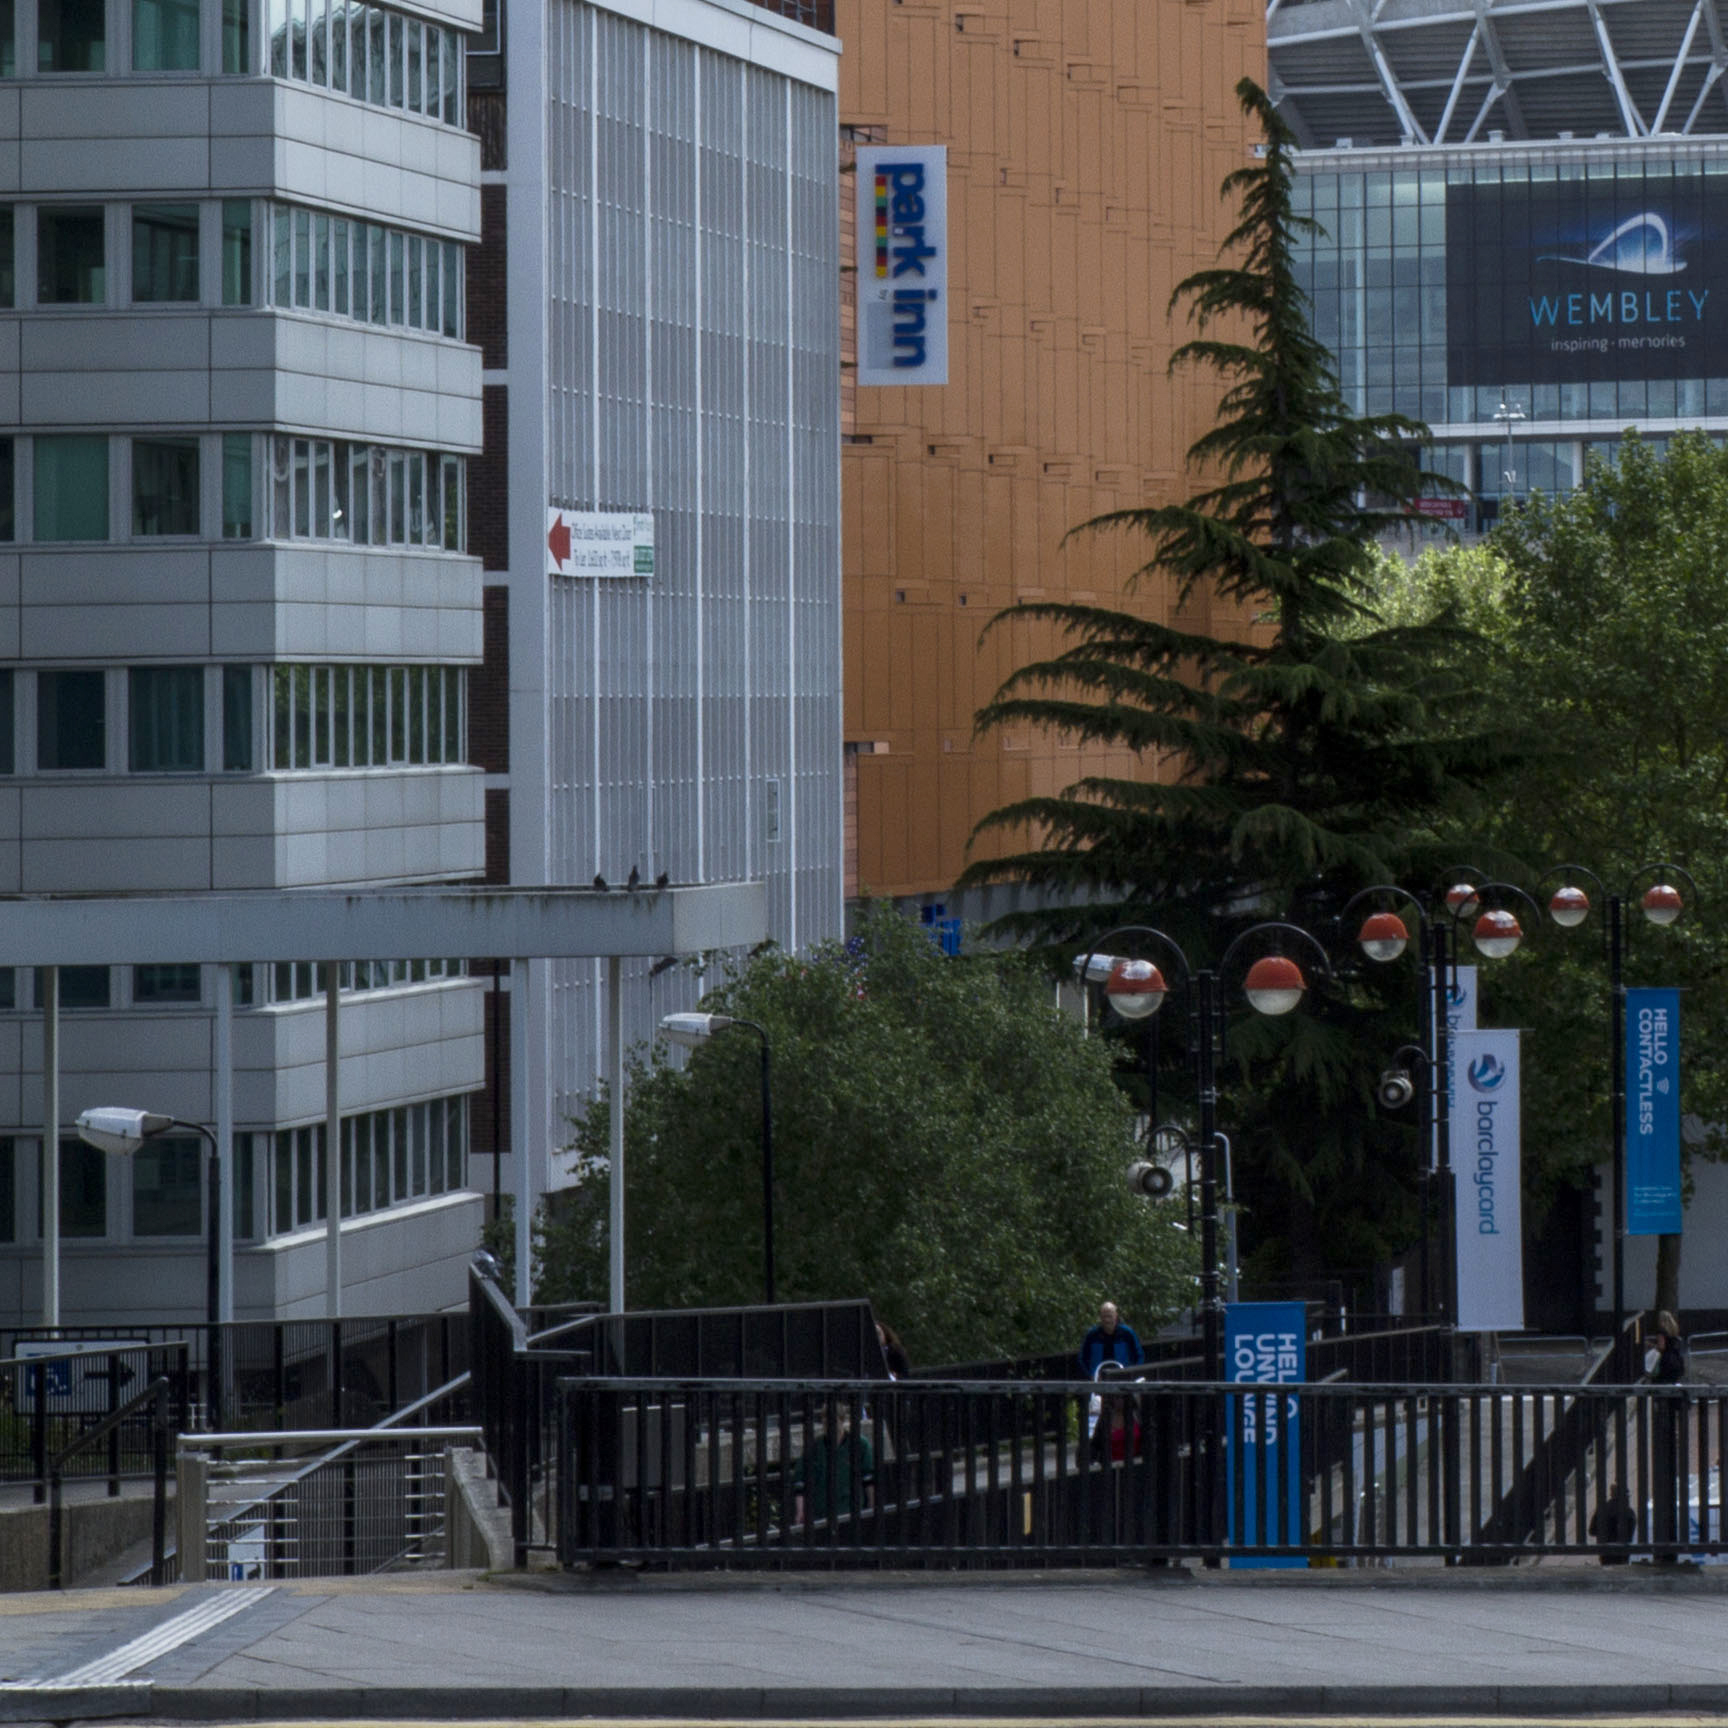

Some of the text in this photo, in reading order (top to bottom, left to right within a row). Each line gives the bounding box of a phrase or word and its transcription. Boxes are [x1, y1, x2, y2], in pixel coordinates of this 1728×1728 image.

[875, 163, 937, 278] park
[893, 289, 938, 369] inn
[1529, 289, 1710, 327] WEMBLEY
[1550, 333, 1686, 354] inspiring memories
[1638, 1008, 1654, 1136] CONTACTLESS
[1653, 1007, 1668, 1065] HELLO
[1473, 1100, 1501, 1236] barclaycard
[1277, 1332, 1298, 1419] HELO
